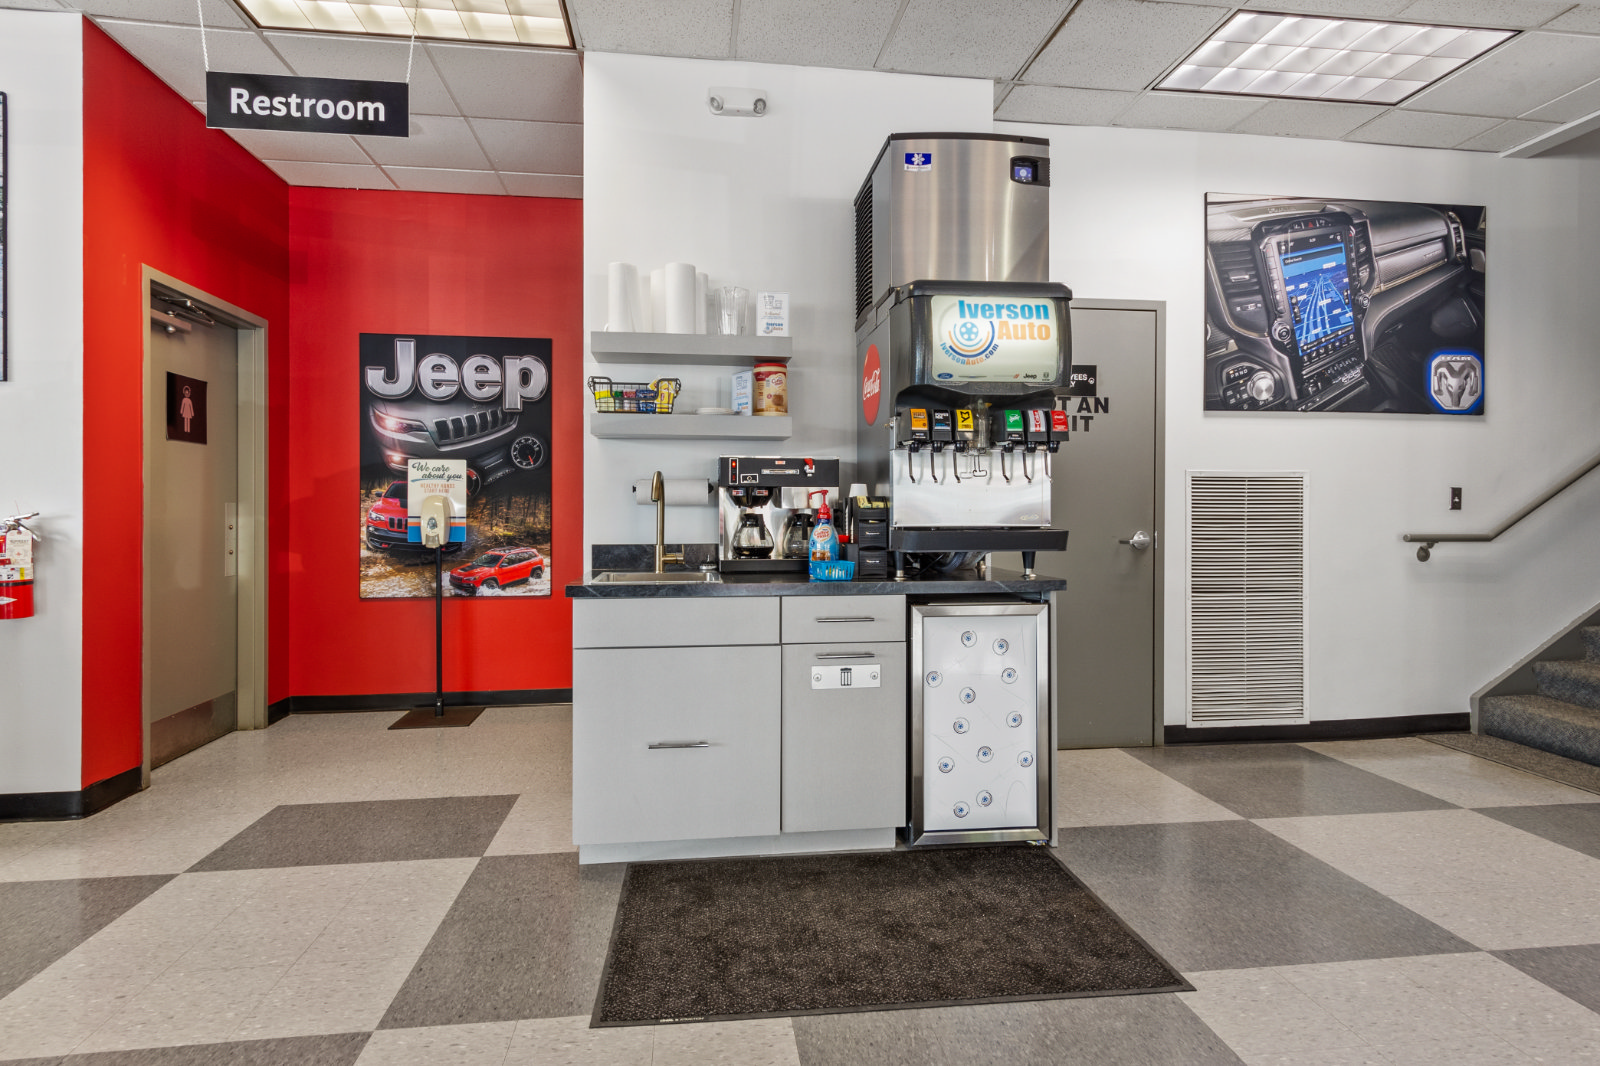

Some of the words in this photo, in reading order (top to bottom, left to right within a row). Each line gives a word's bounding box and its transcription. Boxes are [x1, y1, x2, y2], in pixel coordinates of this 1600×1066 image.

[230, 87, 386, 122] Restroom
[958, 300, 1050, 320] Iverson
[997, 320, 1051, 341] Auto
[940, 342, 1000, 366] IversonAuto.com
[365, 338, 548, 412] Jeep
[1077, 396, 1109, 414] AN
[412, 461, 431, 473] We
[431, 463, 451, 473] care
[421, 472, 446, 480] about
